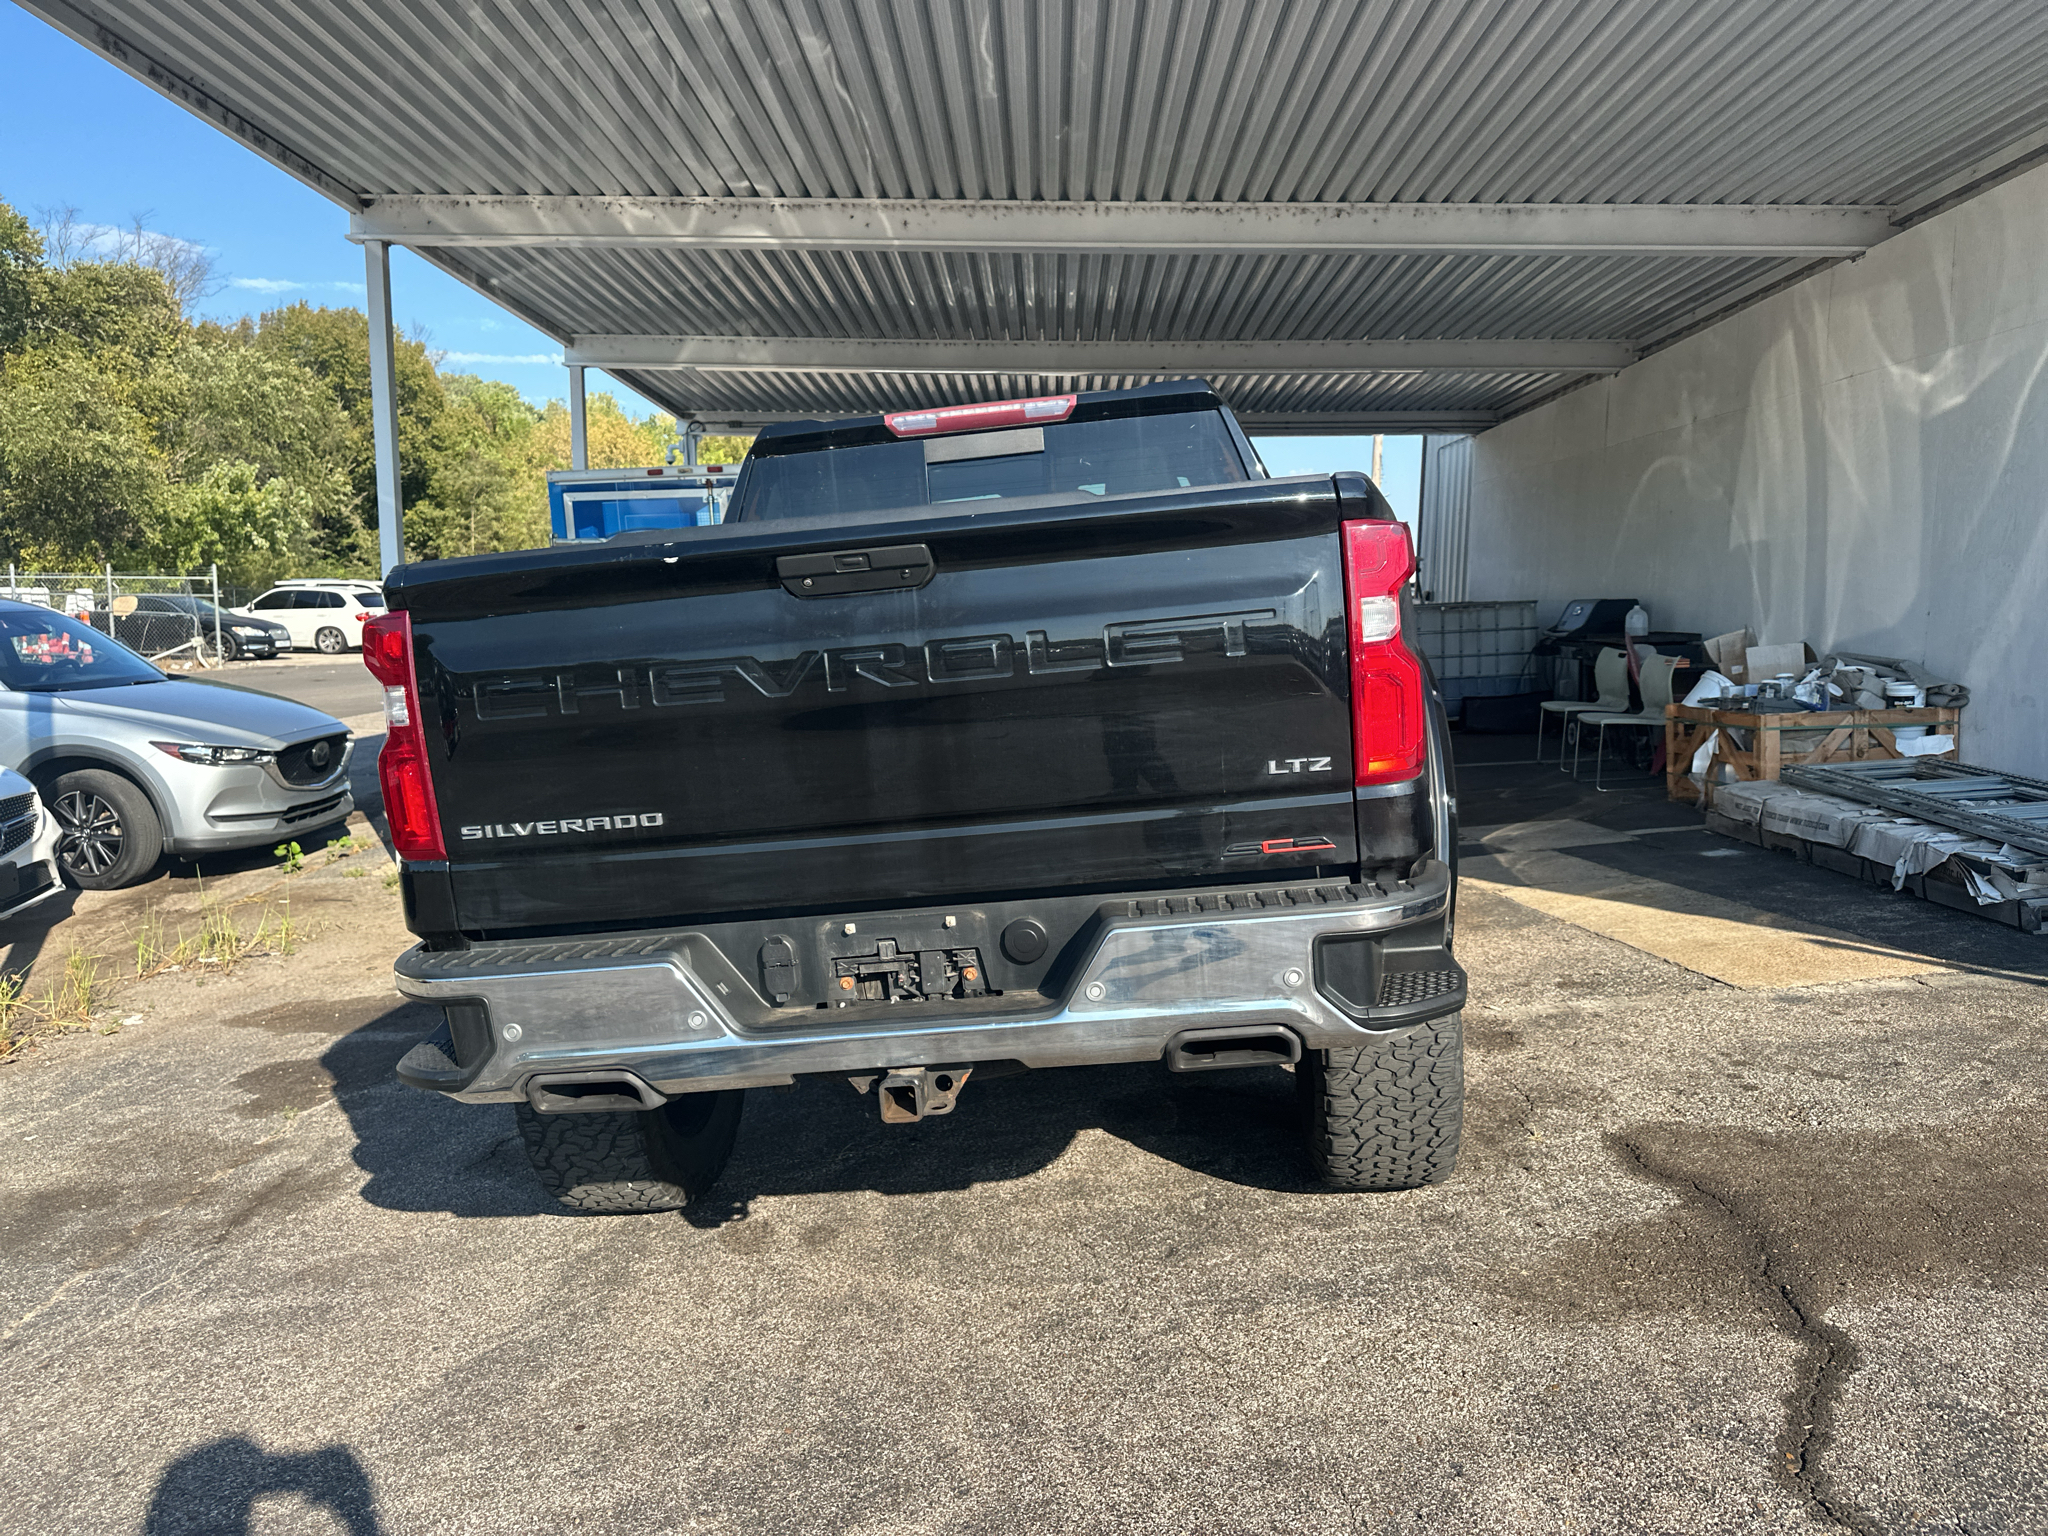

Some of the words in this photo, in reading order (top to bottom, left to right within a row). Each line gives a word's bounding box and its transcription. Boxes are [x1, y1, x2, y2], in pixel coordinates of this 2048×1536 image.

[473, 608, 1278, 722] CHEVROLET
[1267, 756, 1332, 775] LTZ
[460, 812, 664, 840] SILVERADO
